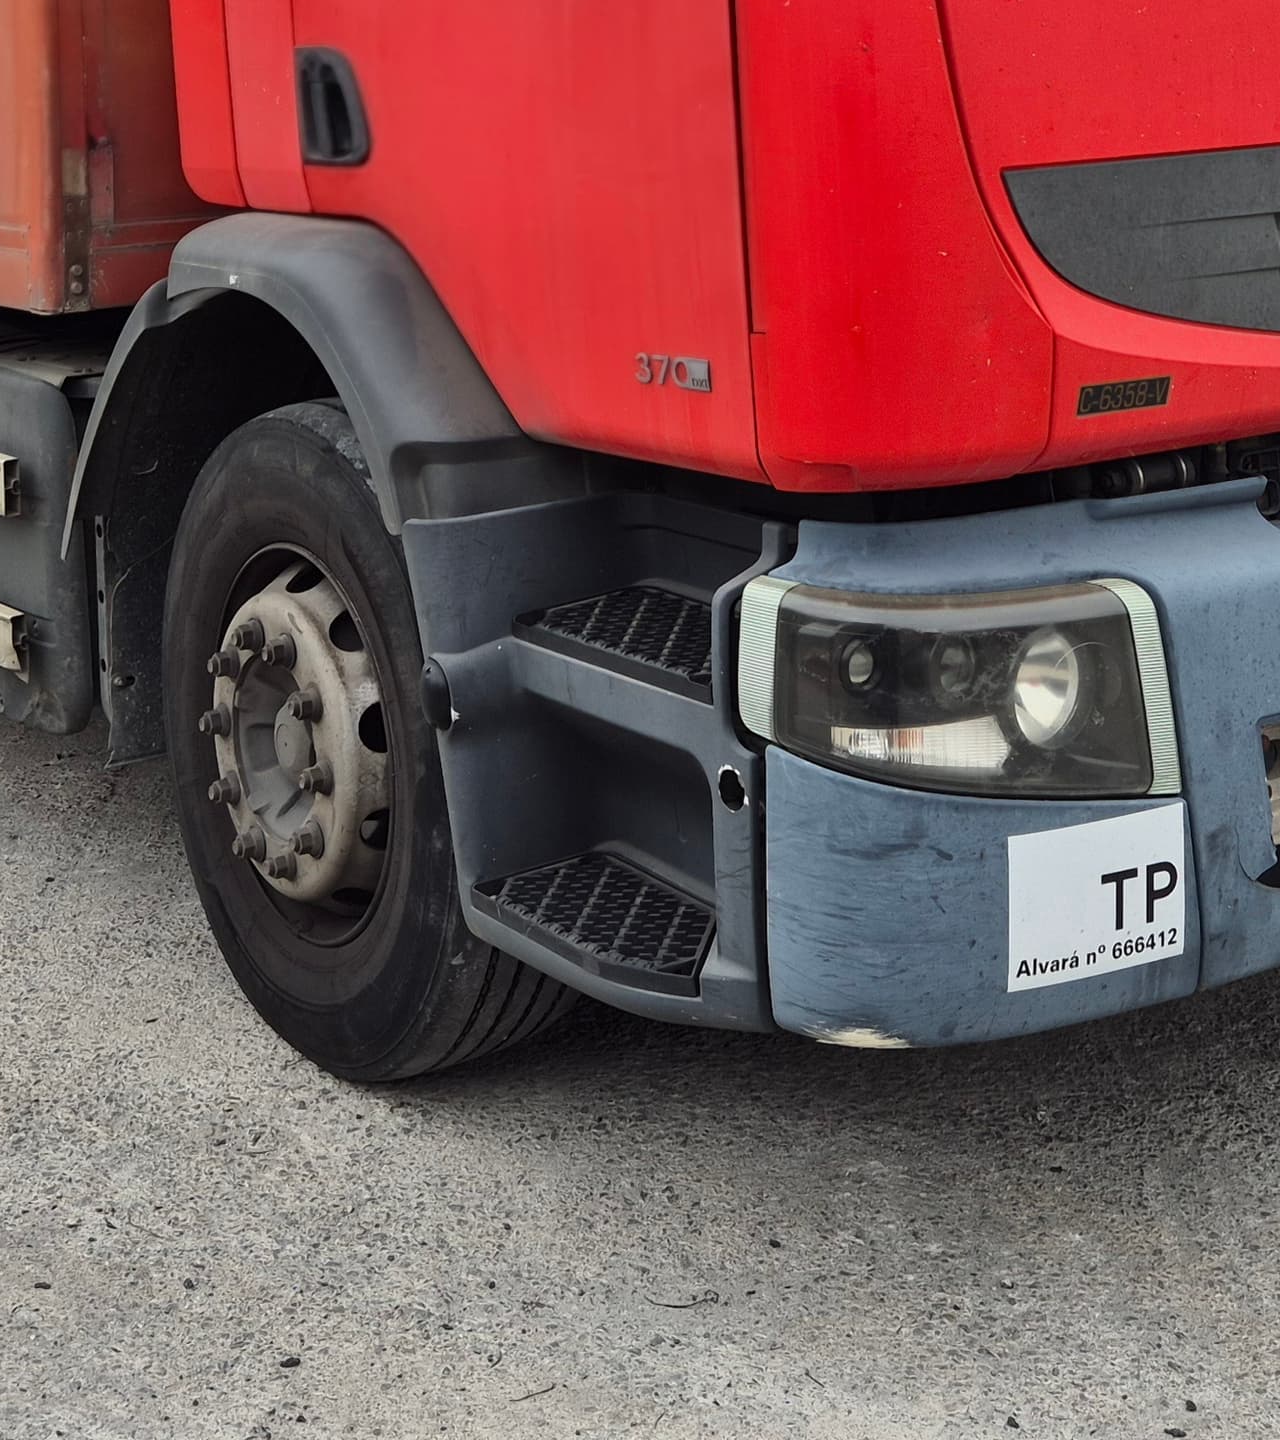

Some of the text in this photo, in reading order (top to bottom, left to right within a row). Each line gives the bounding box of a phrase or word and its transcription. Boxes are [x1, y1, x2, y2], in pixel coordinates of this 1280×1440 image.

[635, 352, 689, 388] 370
[1101, 861, 1178, 931] TP
[1016, 950, 1079, 978] Alvará
[1112, 927, 1178, 959] 666412
